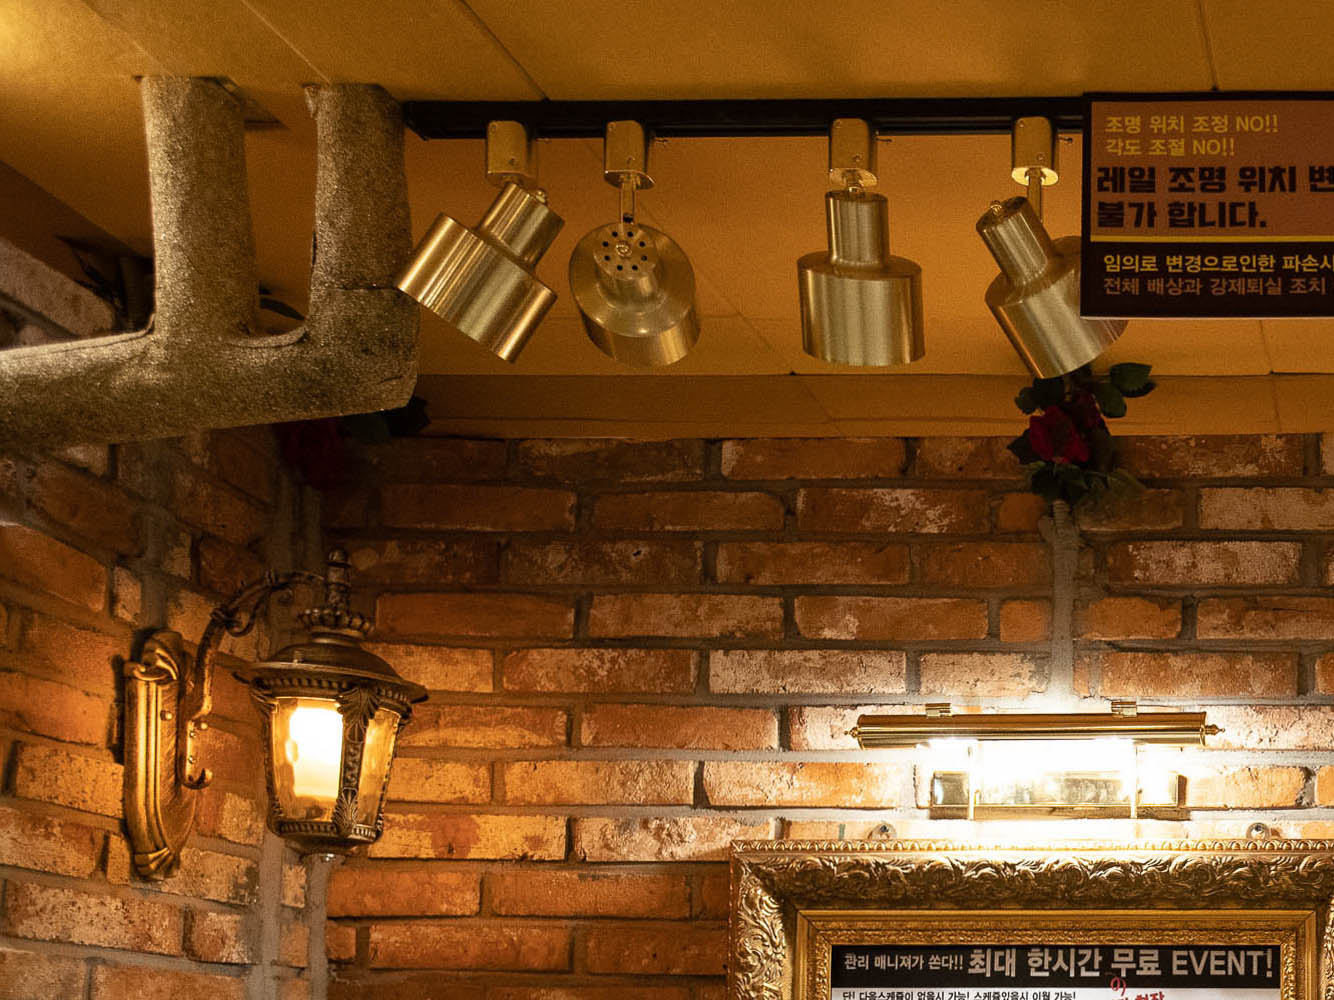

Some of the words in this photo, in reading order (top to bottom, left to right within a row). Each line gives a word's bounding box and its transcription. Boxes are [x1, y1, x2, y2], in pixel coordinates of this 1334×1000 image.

[1105, 116, 1141, 134] 조명
[1150, 116, 1184, 133] 위치
[1193, 116, 1229, 133] 조정
[1236, 115, 1278, 133] NO!!
[1106, 139, 1142, 156] 각도
[1150, 139, 1185, 156] 조절
[1193, 139, 1235, 156] NO!!
[1098, 167, 1156, 193] 레일
[1168, 167, 1226, 192] 조명
[1238, 166, 1296, 193] 위치
[1098, 202, 1156, 228] 불가
[1168, 202, 1266, 228] 합니다.
[1104, 255, 1158, 273] 임의로
[1166, 255, 1275, 273] 변경으로인한
[1104, 278, 1139, 295] 전체
[1148, 278, 1203, 295] 배상과
[1211, 278, 1282, 295] 강제퇴실
[1290, 278, 1326, 295] 조치
[844, 955, 869, 969] 관리
[929, 955, 963, 970] 쏜다!!
[968, 949, 1015, 977] 최대
[1027, 948, 1102, 977] 한시간
[1112, 950, 1162, 977] 무료
[1173, 949, 1273, 977] EVENT!
